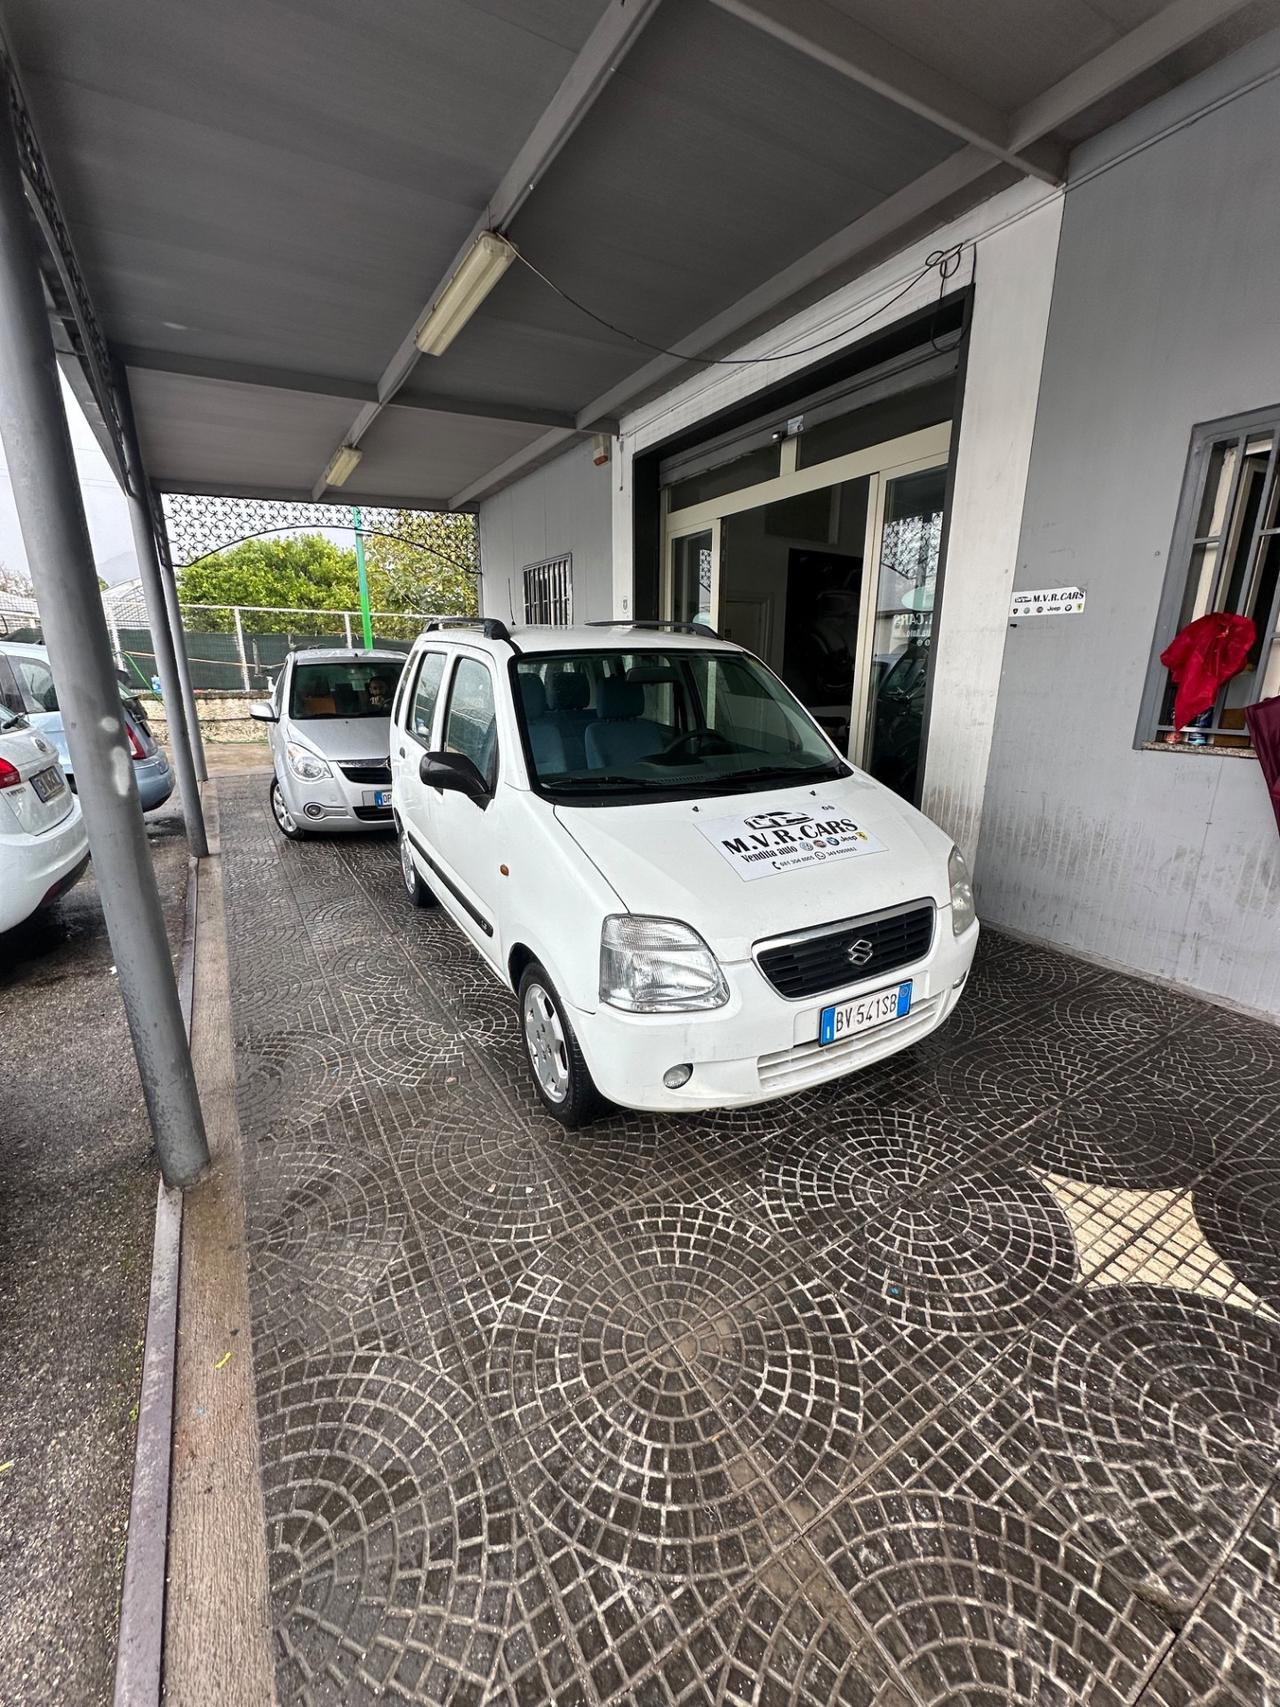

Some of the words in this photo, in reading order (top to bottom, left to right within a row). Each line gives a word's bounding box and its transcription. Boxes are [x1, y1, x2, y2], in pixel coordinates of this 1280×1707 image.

[721, 818, 858, 854] M.V.R.CARS
[741, 850, 778, 863] Vendita
[777, 846, 798, 855] auto
